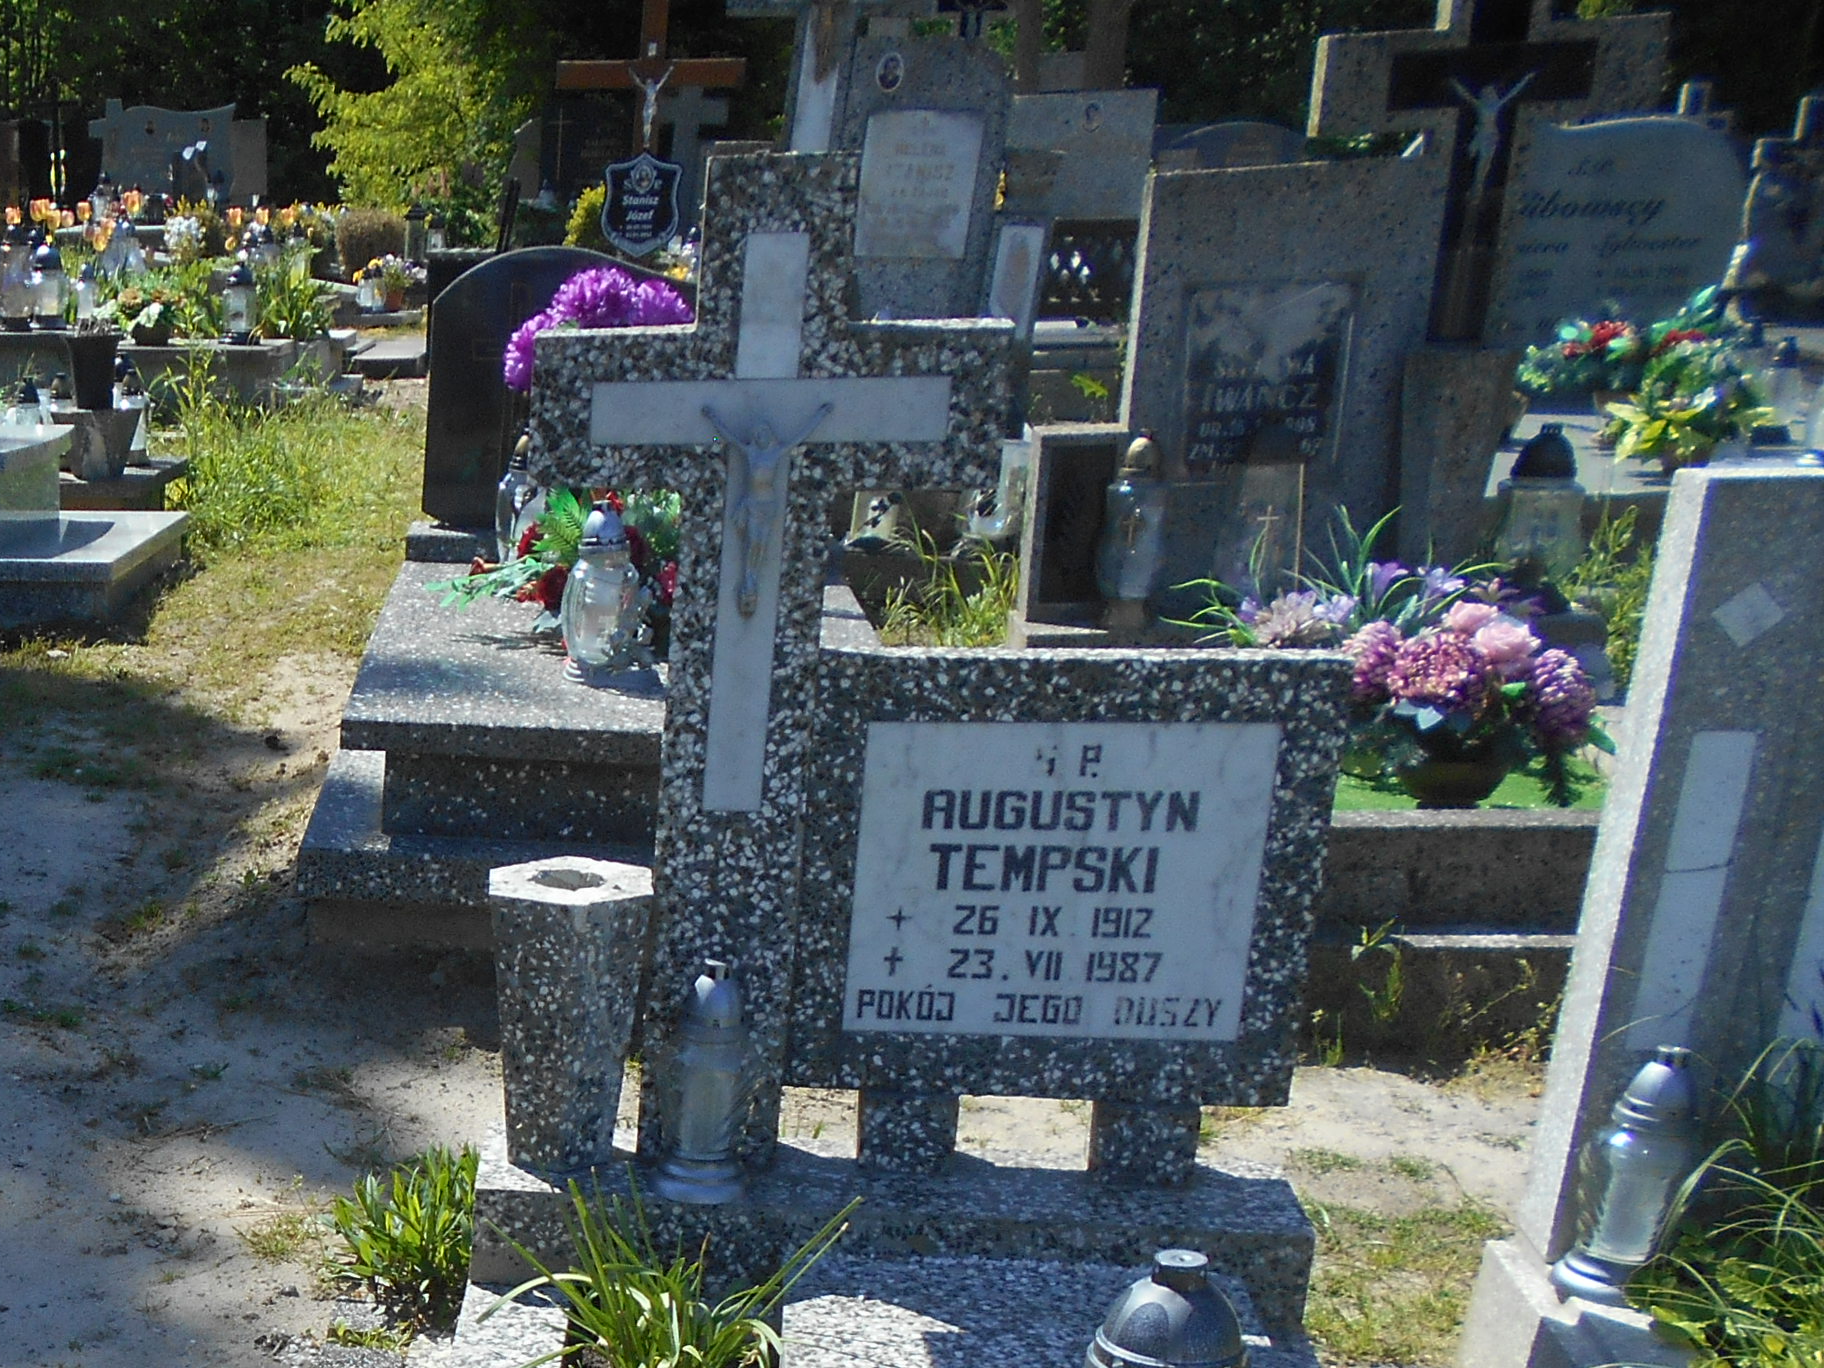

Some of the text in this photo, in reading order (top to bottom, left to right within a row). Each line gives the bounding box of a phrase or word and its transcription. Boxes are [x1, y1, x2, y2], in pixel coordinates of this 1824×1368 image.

[622, 194, 660, 207] Stanisz
[625, 209, 655, 223] Józef
[921, 788, 1201, 832] AUGUSTYN
[929, 843, 1161, 894] TEMPSKI
[952, 904, 1000, 936] 26
[1090, 907, 1155, 939] 1912
[1085, 951, 1164, 984] 1987
[856, 983, 1224, 1030] POKÓJ JEGO DUSZY
